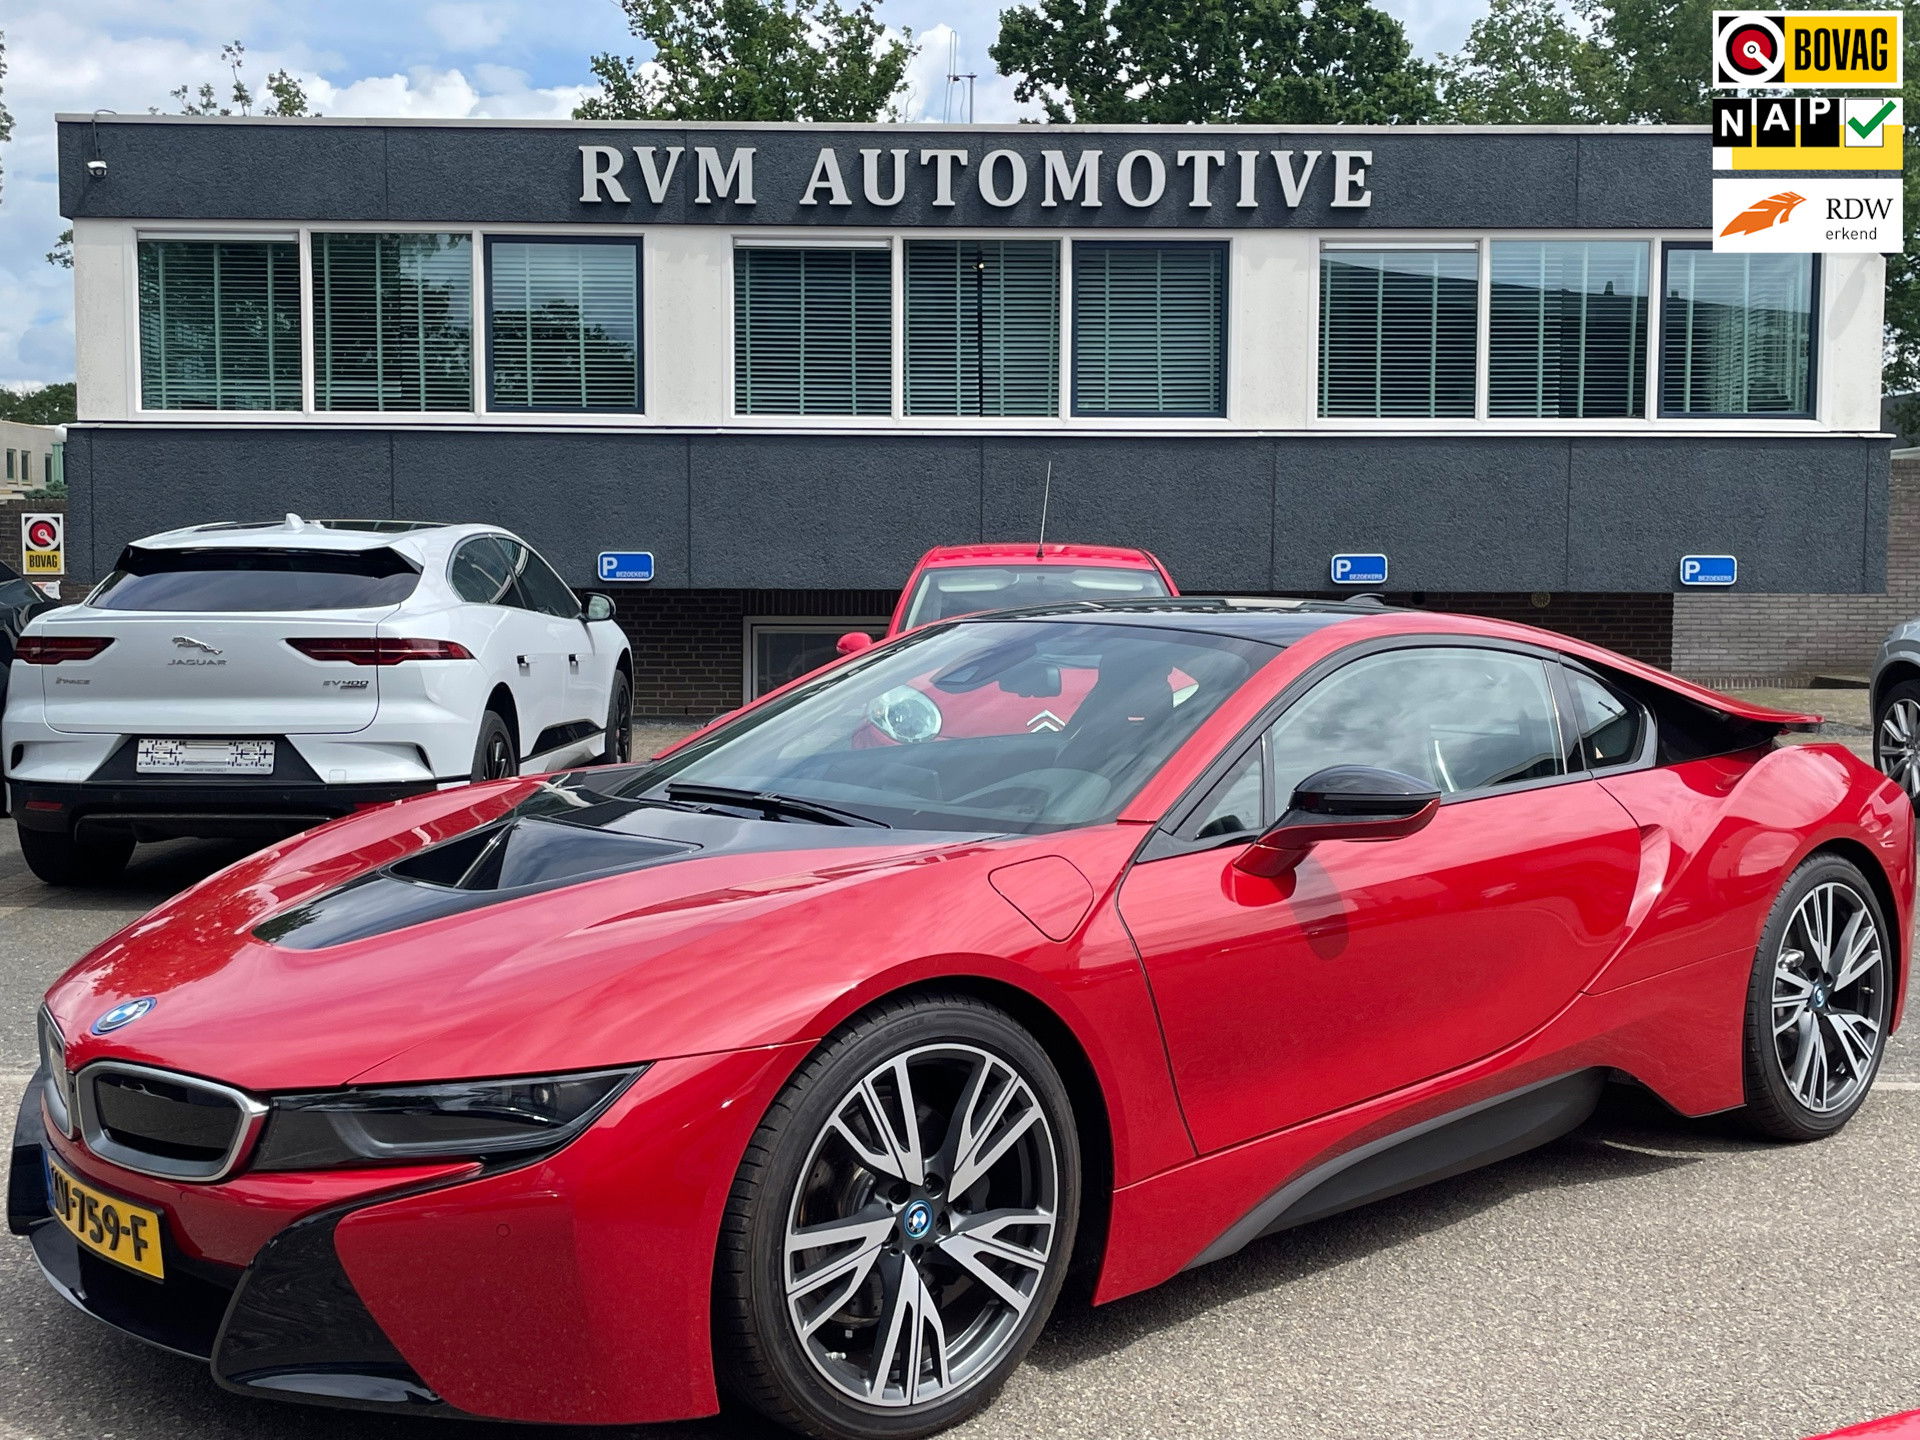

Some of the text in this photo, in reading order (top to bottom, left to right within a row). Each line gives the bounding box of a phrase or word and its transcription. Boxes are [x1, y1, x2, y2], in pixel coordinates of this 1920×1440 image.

[579, 145, 1374, 208] RVM AUTOMOTIVE
[29, 554, 58, 568] BOVAG
[602, 556, 618, 577] P
[1336, 559, 1352, 579] P
[1685, 560, 1701, 580] P
[615, 570, 650, 578] BEZOEKERS
[167, 658, 228, 667] JAGUAR
